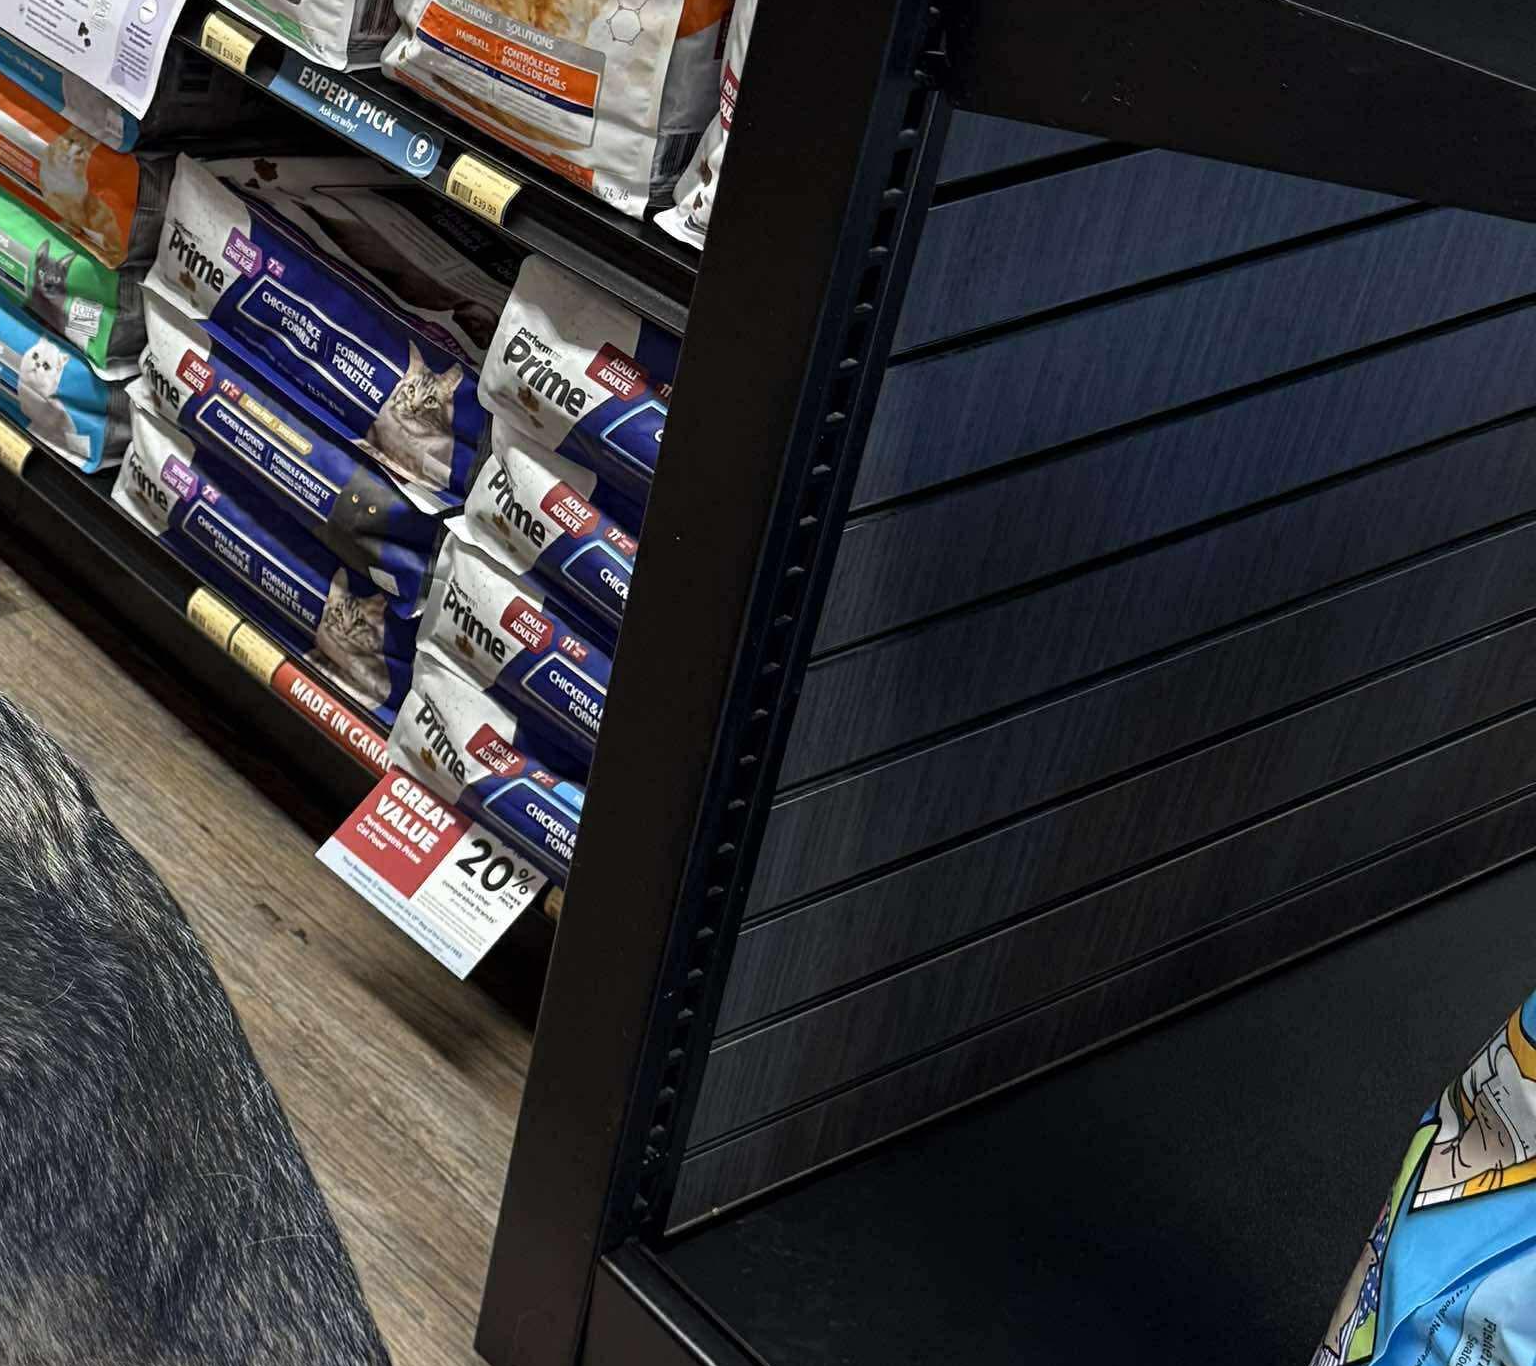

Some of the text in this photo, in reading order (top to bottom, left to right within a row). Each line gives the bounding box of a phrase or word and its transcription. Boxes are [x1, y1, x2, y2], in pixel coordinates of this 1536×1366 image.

[505, 21, 554, 51] SOLUTIONS
[298, 65, 398, 137] EXPERT PICK
[318, 104, 358, 133] Ask us why!
[473, 195, 497, 216] $39.99
[169, 229, 224, 293] Prime
[235, 237, 258, 260] SENIOR
[262, 291, 300, 322] CHICKEN
[281, 316, 318, 353] FORMULA
[190, 361, 210, 379] ADULT
[335, 342, 376, 380] FORMULE
[503, 335, 587, 418] Prime
[610, 357, 641, 382] ADULT
[332, 350, 361, 385] POULET
[367, 384, 384, 404] RIZ
[597, 367, 634, 396] ADULTE
[550, 505, 583, 533] ADULTE
[562, 495, 593, 520] ADULT
[197, 515, 229, 546] CHICKEN
[261, 578, 291, 609] POULET
[262, 567, 300, 600] FORMULE
[443, 584, 506, 664] Prime
[510, 620, 542, 649] ADULTE
[519, 610, 547, 633] ADULT
[548, 669, 598, 715] CHICKEN &
[290, 678, 393, 773] MADE IN CANA
[415, 702, 465, 786] Prime
[488, 739, 520, 765] ADULT
[391, 777, 455, 833] GREAT
[356, 822, 387, 851] Cat Food
[375, 794, 439, 854] VALUE
[525, 803, 567, 840] CHICKEN
[401, 843, 422, 865] Prime
